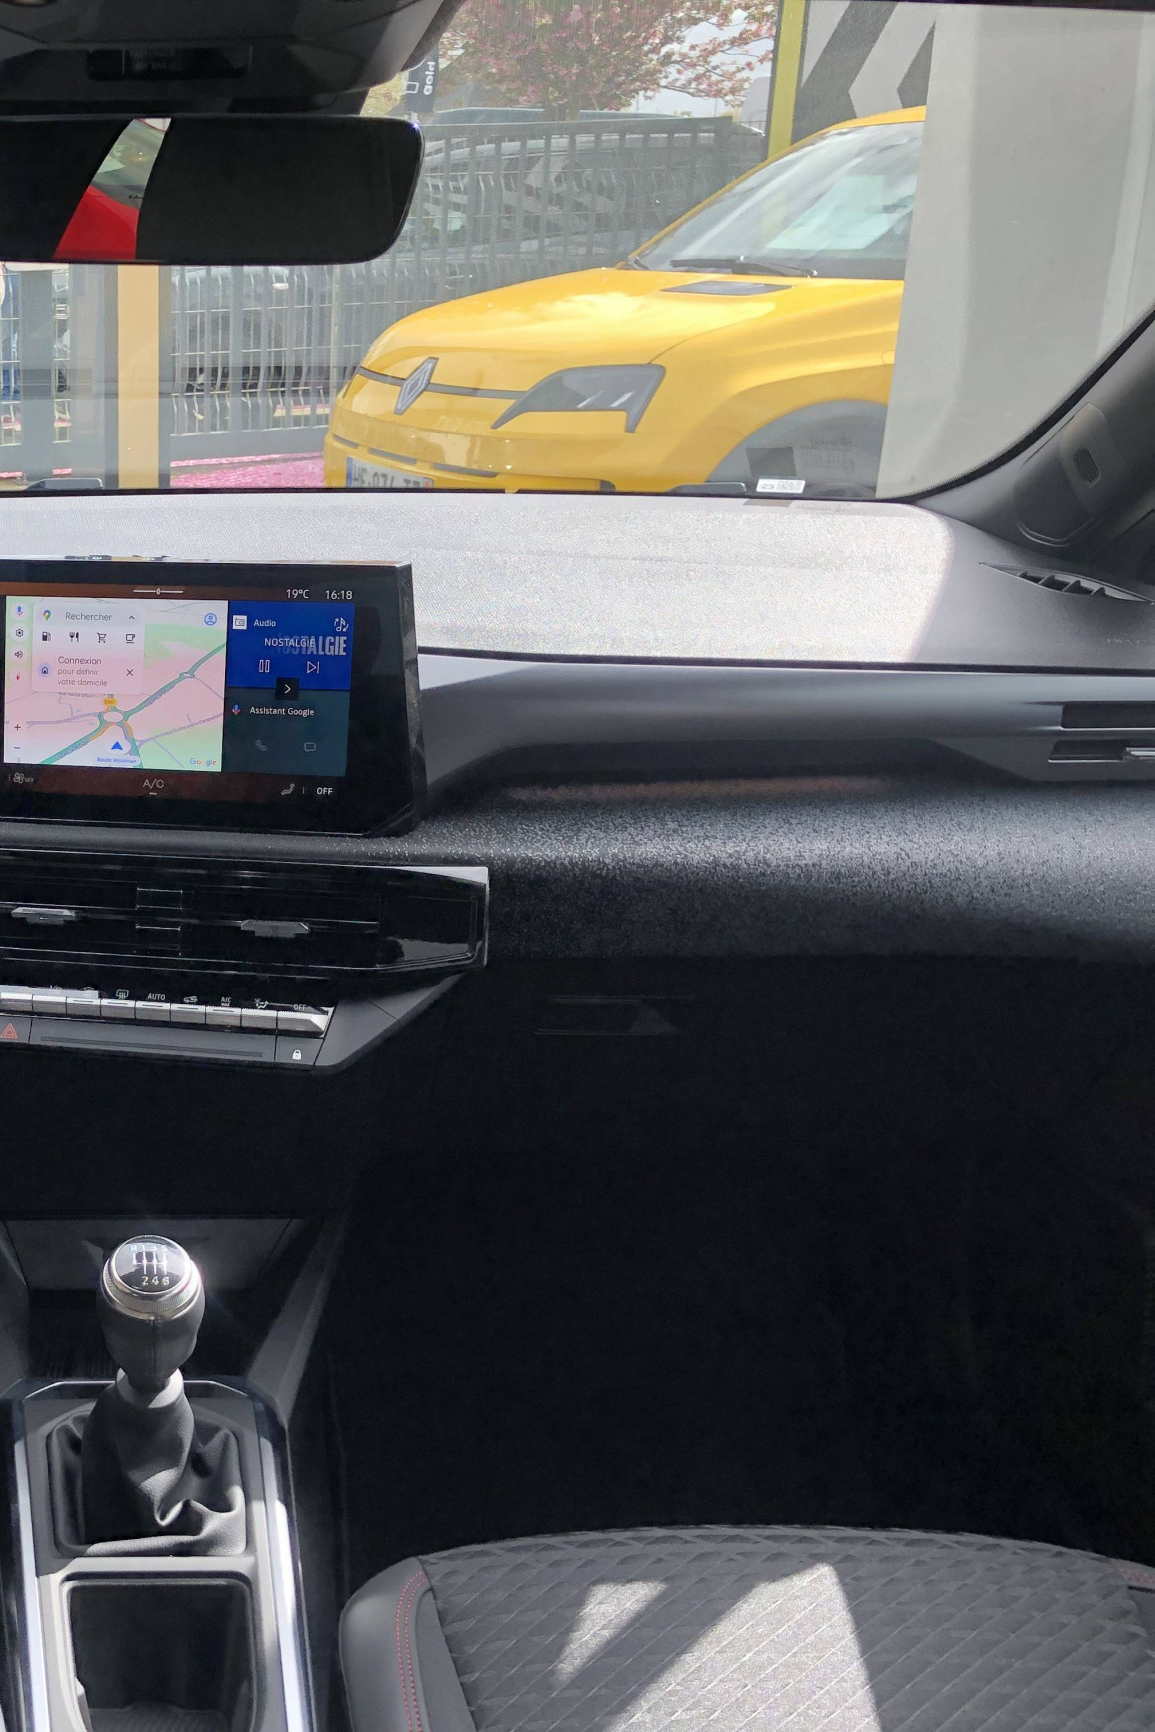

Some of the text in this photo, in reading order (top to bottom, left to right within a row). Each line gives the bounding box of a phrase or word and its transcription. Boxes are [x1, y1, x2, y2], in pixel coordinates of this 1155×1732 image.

[286, 589, 353, 600] 19°C 16:18
[65, 611, 112, 621] Rechercher
[253, 619, 277, 628] Audio
[264, 637, 315, 648] NOSTALGIE
[58, 656, 102, 665] Connexion
[77, 678, 108, 687] domicile
[249, 706, 315, 718] Assistant Google
[189, 757, 218, 768] Google
[142, 778, 165, 790] A/C
[316, 787, 333, 796] OFF
[147, 992, 166, 1001] AUTO
[293, 1003, 307, 1012] OFF
[130, 1244, 138, 1252] R
[161, 1244, 169, 1252] 5
[141, 1275, 170, 1286] 2 4 6
